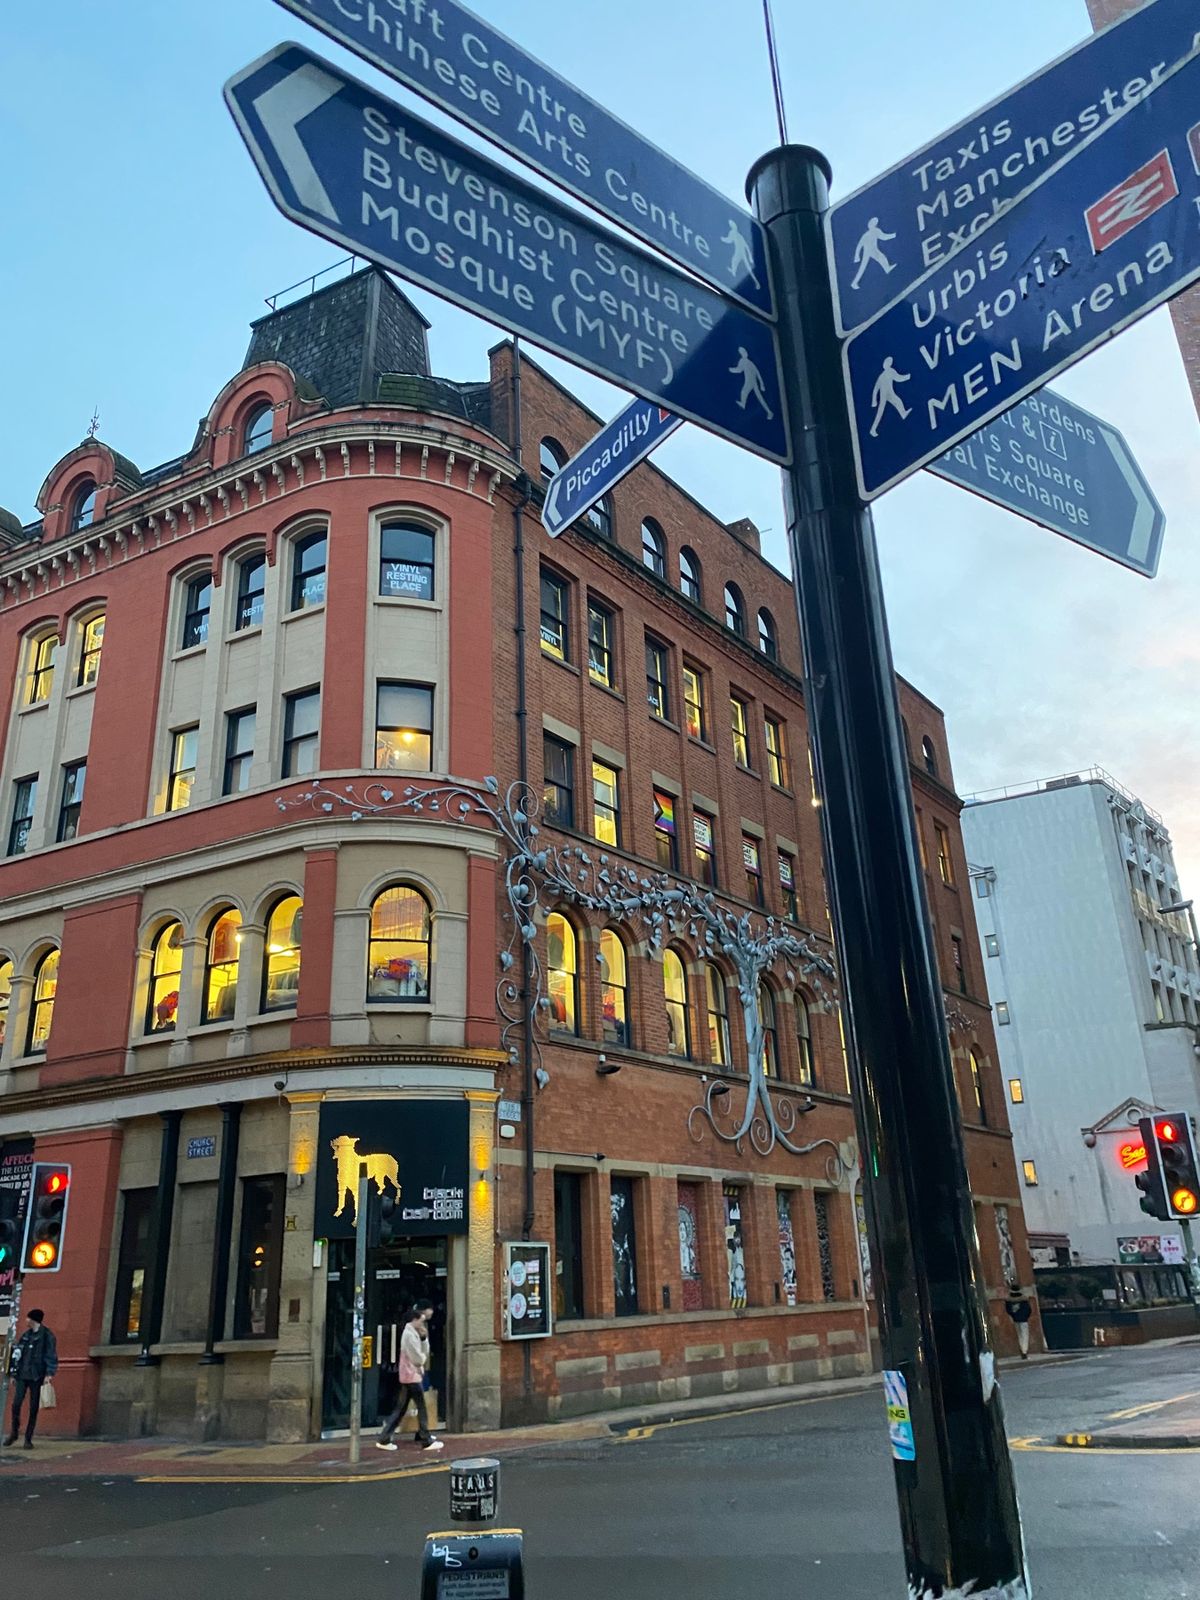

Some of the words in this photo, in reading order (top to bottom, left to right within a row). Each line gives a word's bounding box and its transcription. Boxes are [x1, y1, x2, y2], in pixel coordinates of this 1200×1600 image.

[334, 0, 501, 116] Chinese
[517, 109, 591, 177] Arts
[605, 168, 710, 258] Centre
[462, 32, 588, 138] Centre
[912, 119, 1012, 191] Taxis
[916, 61, 1166, 232] Manchester
[362, 106, 577, 256] Stevenson
[594, 241, 713, 331] Square
[362, 147, 555, 282] Buddhist
[569, 267, 688, 354] Centre
[361, 190, 535, 310] Mosque
[551, 294, 674, 385] (MYF)
[911, 241, 1009, 329] Urbis
[919, 247, 1072, 370] Victoria
[927, 337, 1023, 430] MEN
[1042, 241, 1174, 353] Arena
[566, 407, 653, 501] Piccadilly
[1022, 396, 1096, 445] ardens
[984, 454, 1090, 526] Exchange
[1008, 439, 1086, 497] Square
[386, 570, 428, 584] RESTING
[390, 580, 422, 592] PLACE
[391, 563, 421, 574] VINYL
[188, 1146, 214, 1157] STREET
